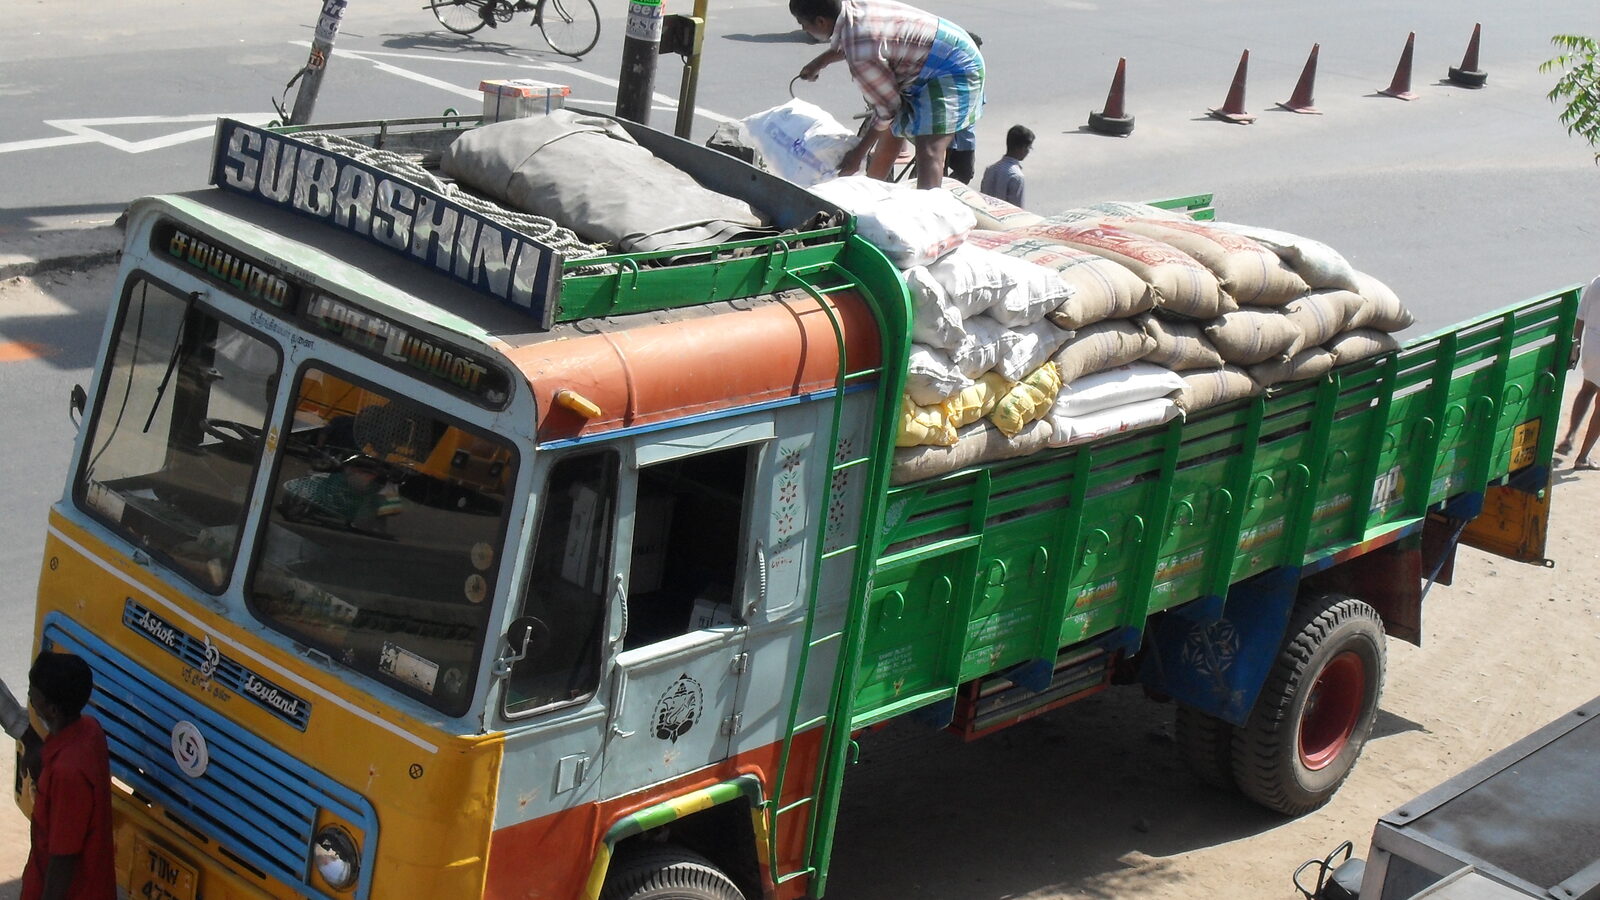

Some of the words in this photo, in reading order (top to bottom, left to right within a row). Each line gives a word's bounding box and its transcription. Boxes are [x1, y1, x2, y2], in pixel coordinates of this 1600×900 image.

[224, 126, 541, 308] SUBASHINI
[139, 611, 176, 648] Ashok
[244, 675, 299, 716] Leyland
